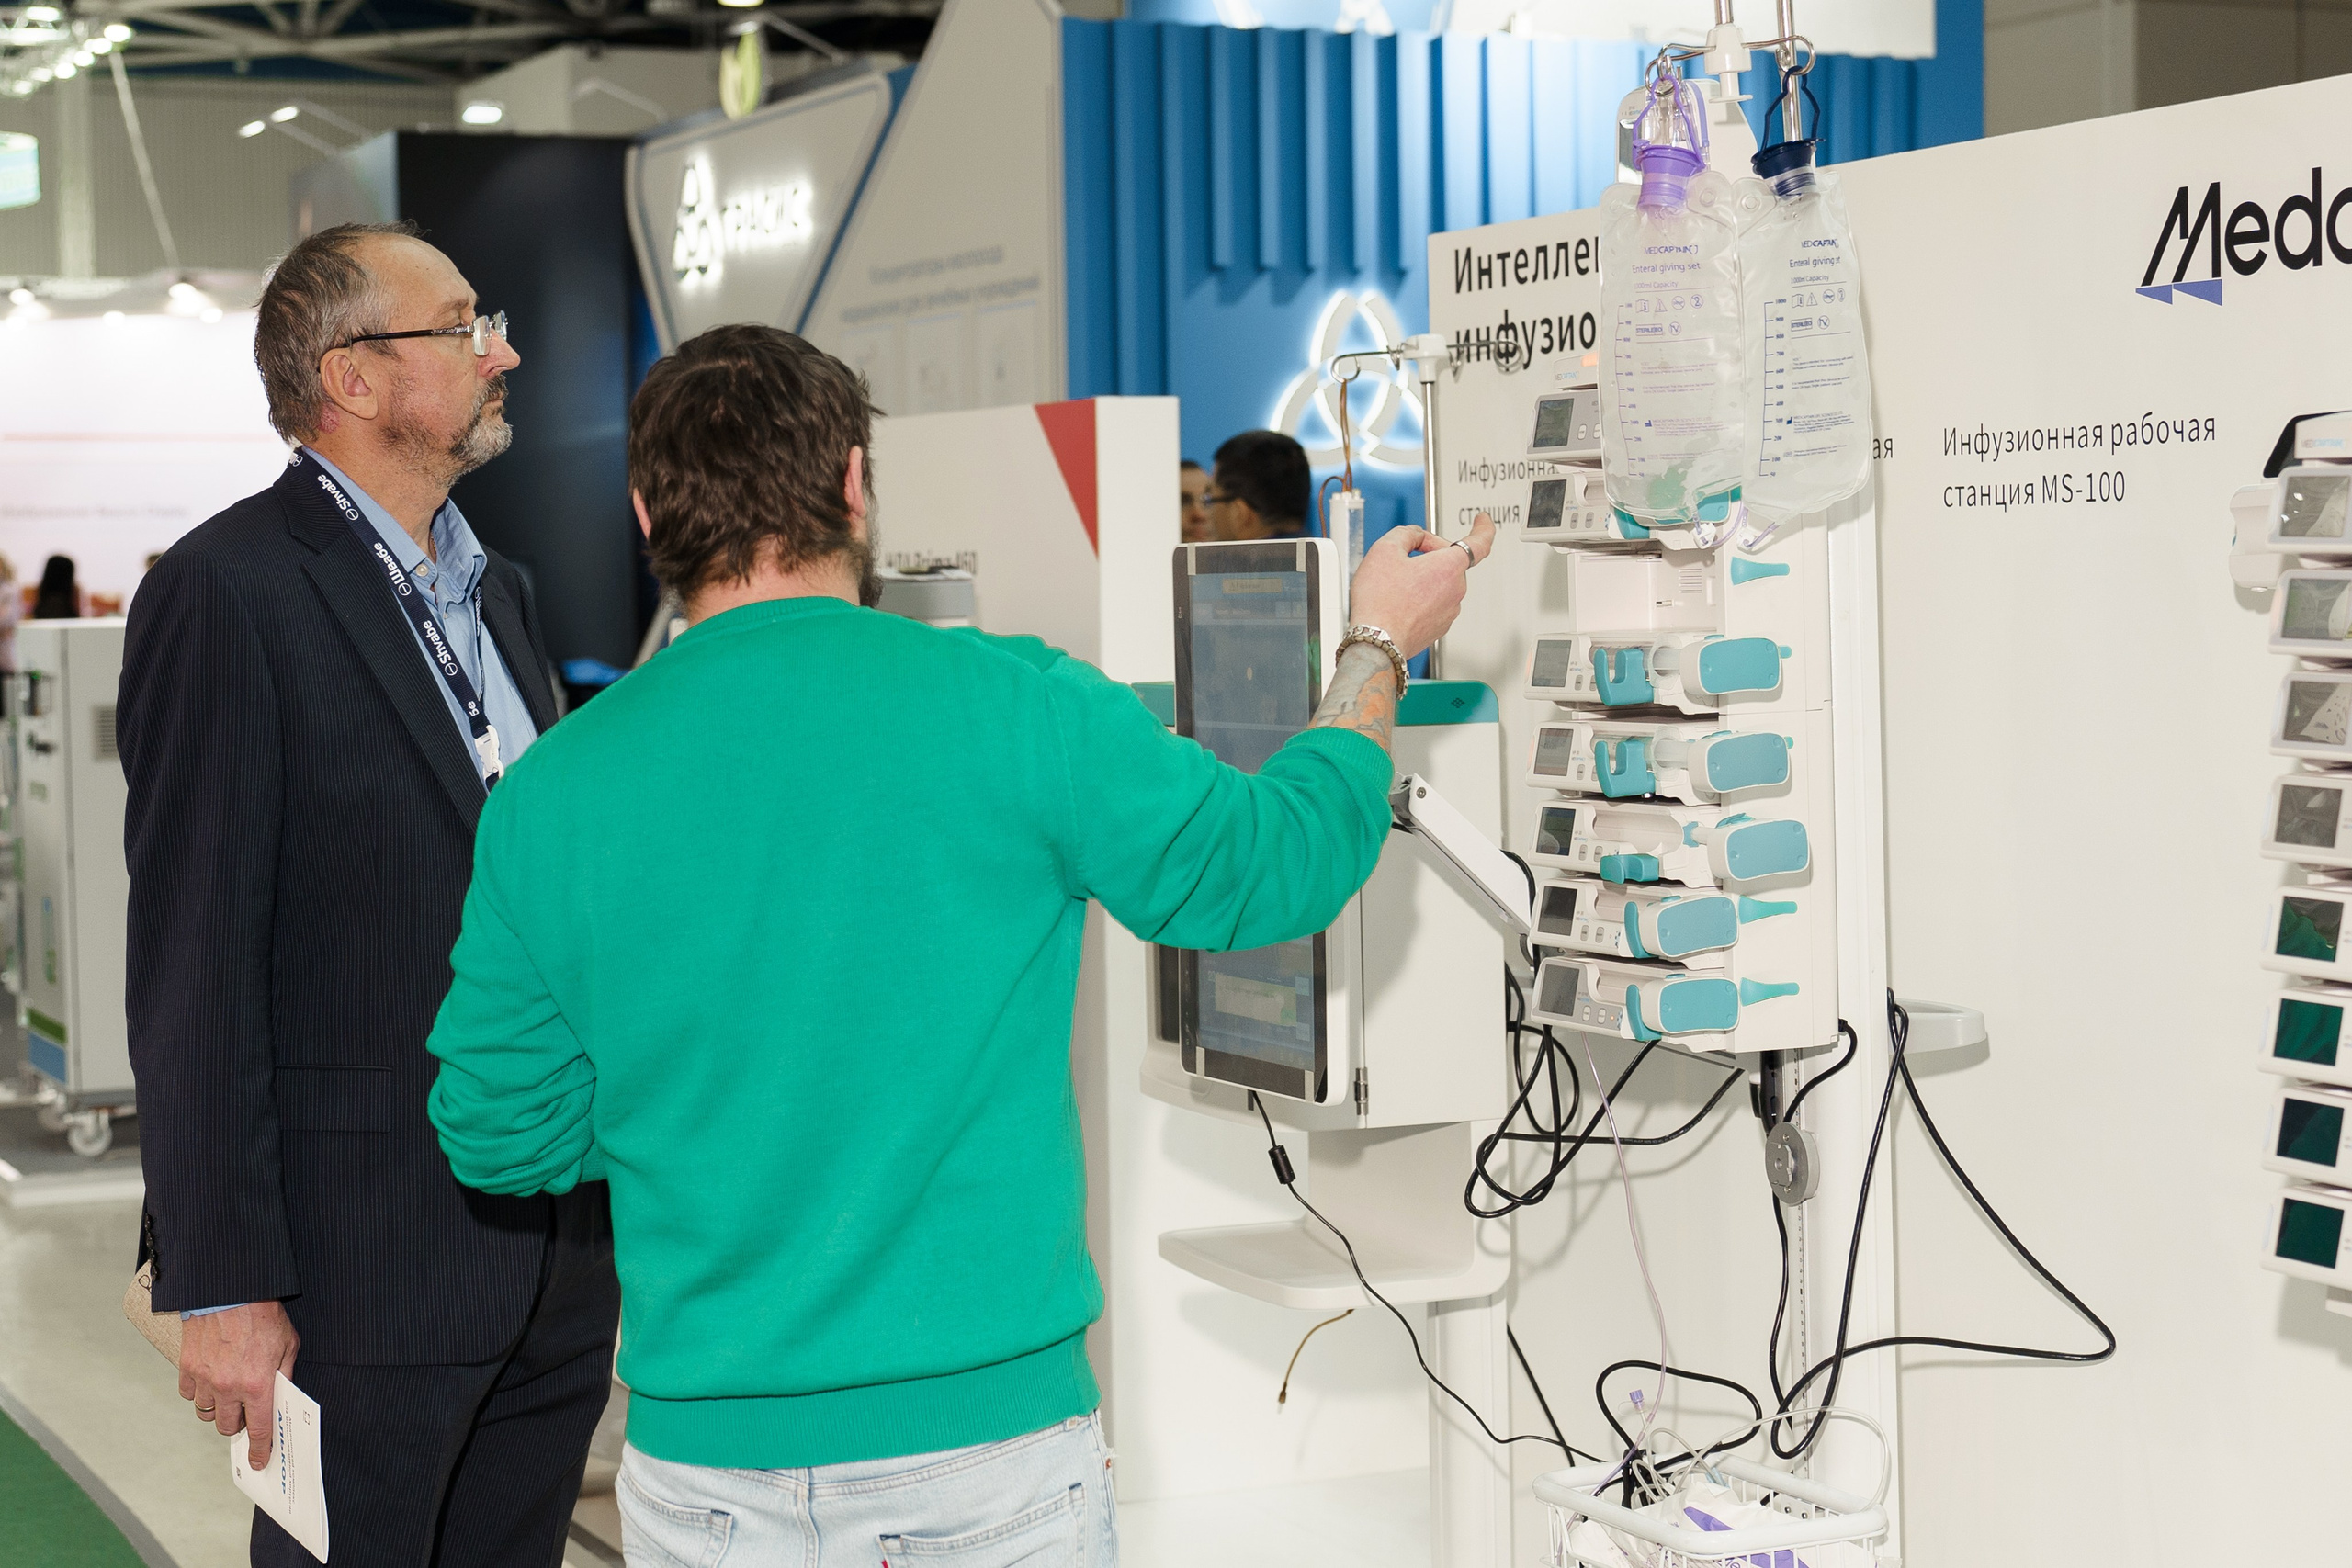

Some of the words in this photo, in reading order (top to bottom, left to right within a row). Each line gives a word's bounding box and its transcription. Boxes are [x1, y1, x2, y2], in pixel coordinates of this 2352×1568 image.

[1632, 265, 1657, 274] Enteral
[1660, 264, 1685, 274] giving
[1813, 255, 1834, 268] giving
[1943, 423, 2103, 462] Инфузионная
[2111, 412, 2215, 456] рабочая
[317, 474, 351, 511] Shvabe
[1458, 457, 1555, 489] Инфузионна
[1943, 482, 2035, 513] станция
[2041, 470, 2126, 504] MS-100
[373, 542, 406, 585] Швабе
[423, 620, 452, 665] Shvabe
